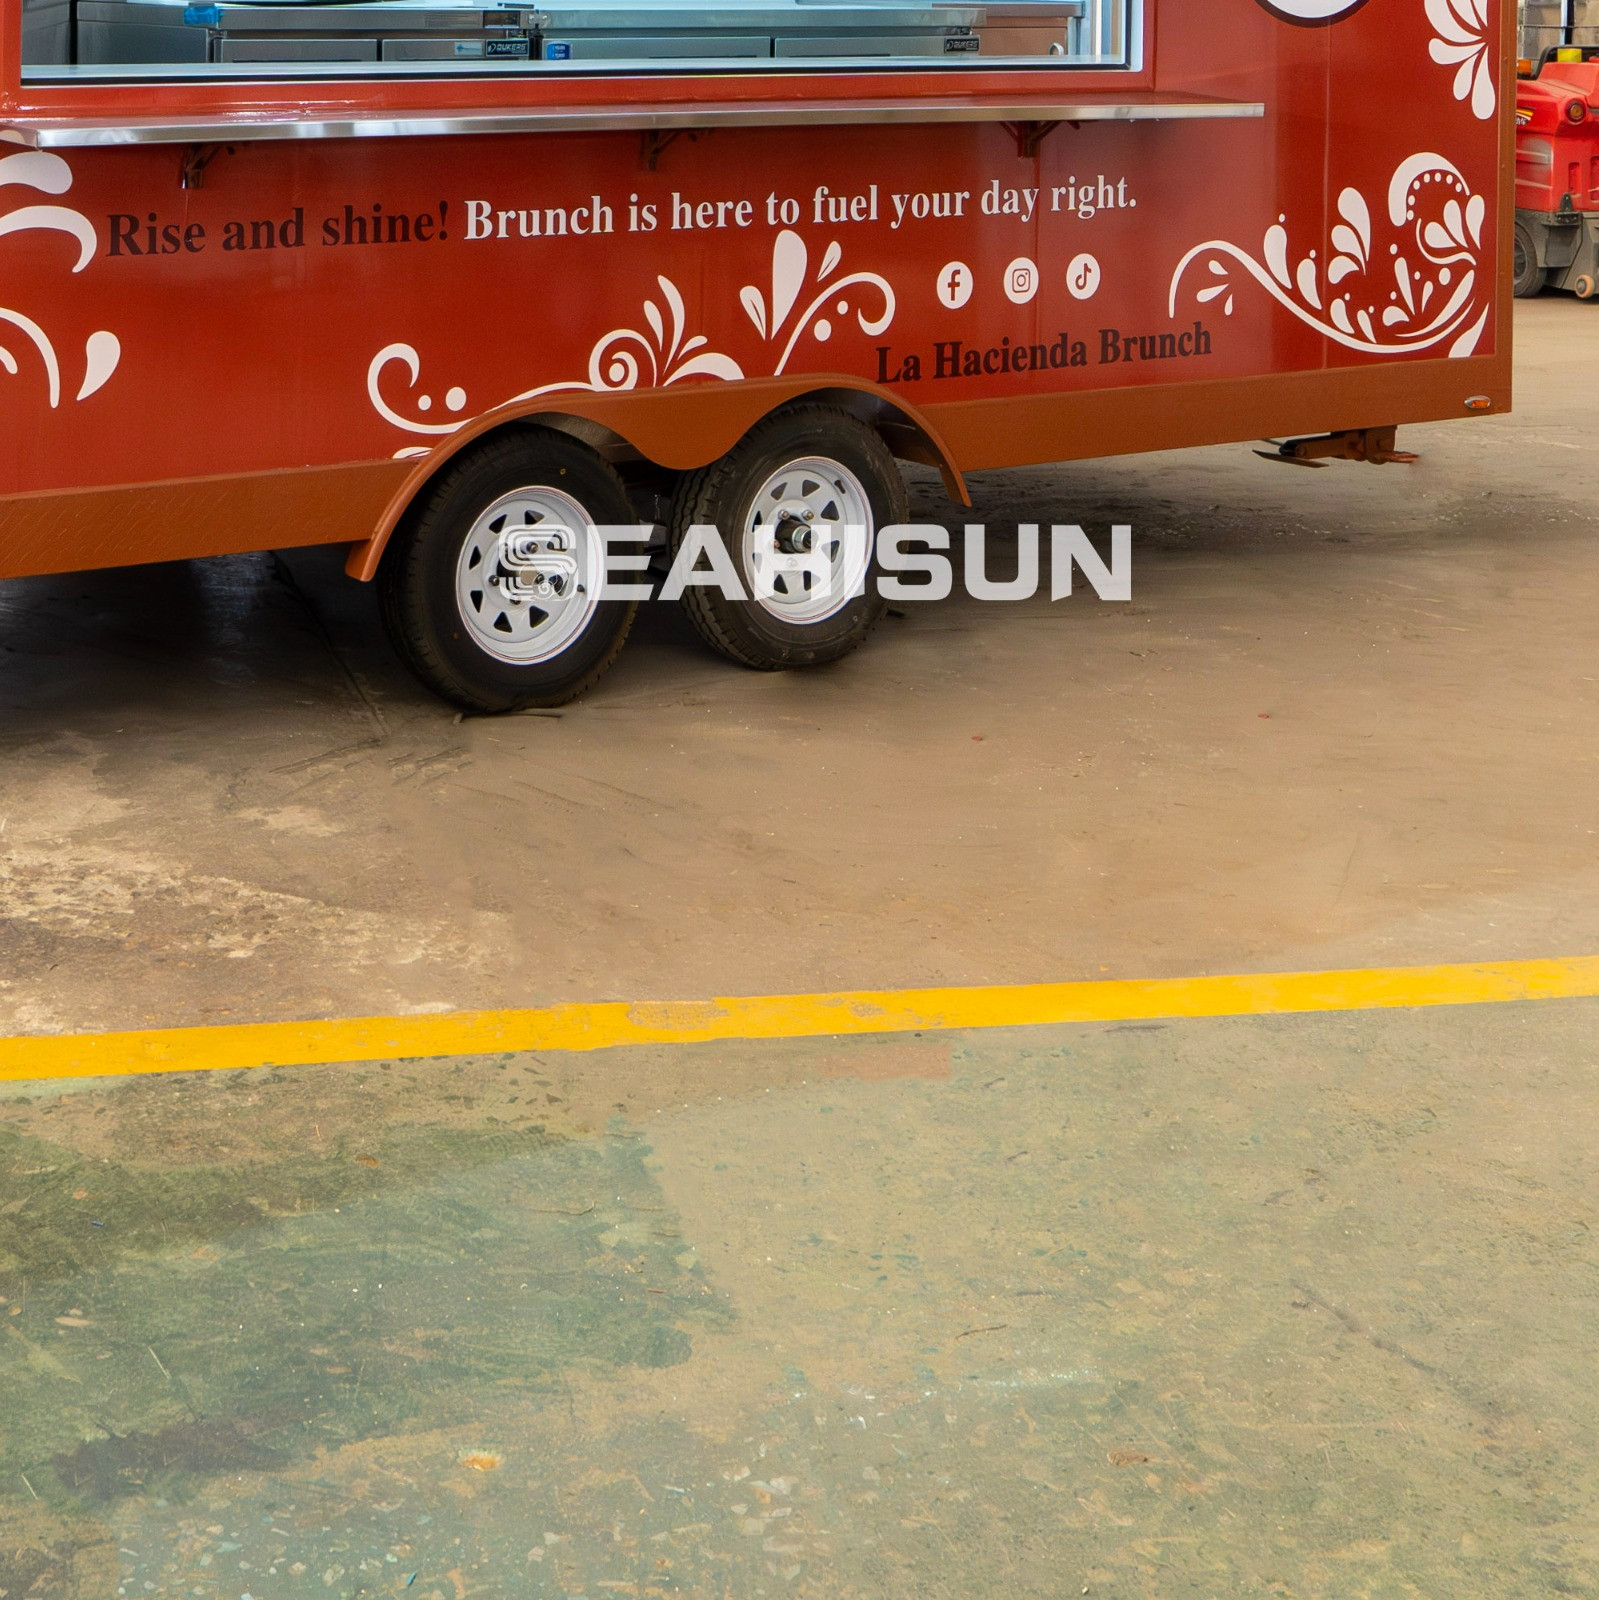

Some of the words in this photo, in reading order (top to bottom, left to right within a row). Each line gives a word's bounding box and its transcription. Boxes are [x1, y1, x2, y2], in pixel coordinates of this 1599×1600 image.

[106, 212, 206, 257] Rise
[222, 206, 305, 251] and
[321, 201, 449, 247] shine!
[463, 195, 614, 240] Brunch
[628, 193, 658, 232] is
[671, 192, 753, 231] here
[765, 192, 800, 226] to
[812, 185, 879, 224] fuel
[890, 189, 972, 229] your
[980, 179, 1040, 224] day
[1050, 175, 1138, 219] right.
[876, 346, 922, 383] La
[934, 332, 1088, 380] Hacienda
[1097, 321, 1212, 365] Brunch
